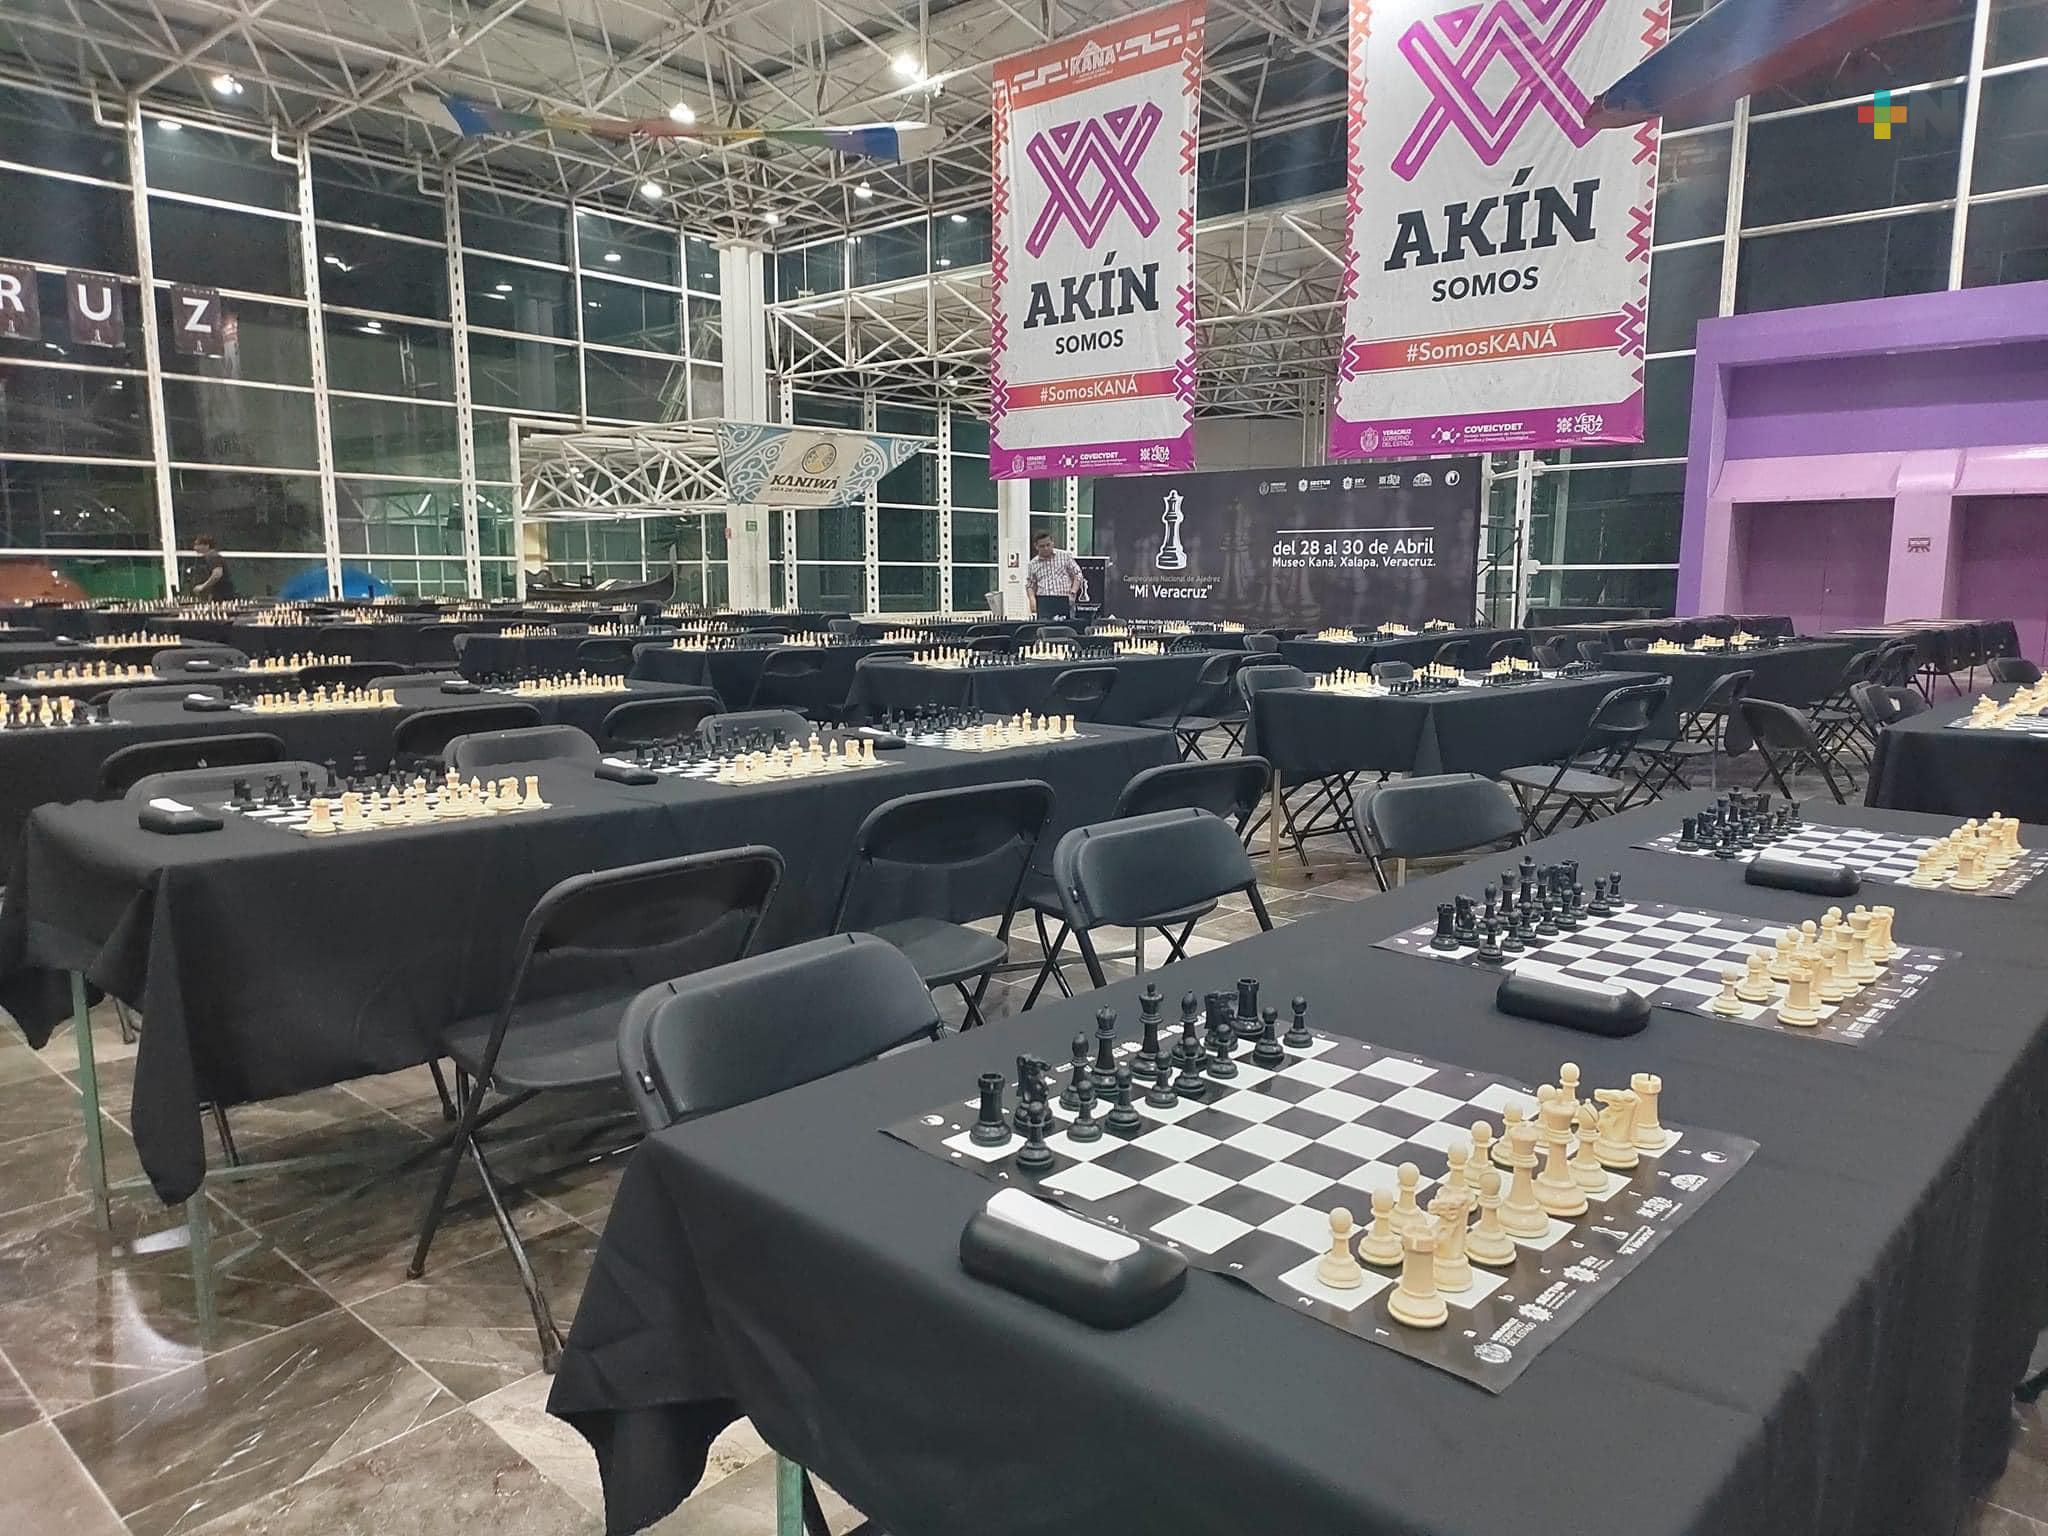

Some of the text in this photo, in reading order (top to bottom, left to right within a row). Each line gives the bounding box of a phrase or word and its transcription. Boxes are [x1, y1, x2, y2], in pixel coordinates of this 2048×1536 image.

[1383, 166, 1601, 272] AKÍN
[1023, 250, 1160, 329] AKÍN
[1431, 266, 1540, 303] SOMOS
[1055, 328, 1124, 355] SOMOS
[1406, 323, 1558, 363] #SomosKANÁ
[1040, 374, 1138, 403] #SomosKANÁ
[1464, 422, 1524, 434] COVEICYDET
[1272, 537, 1434, 556] del 28 al 30 de Abril
[1272, 555, 1436, 570] Museo Kaná, Xalapa, Veracruz.
[1129, 584, 1213, 599] "Mi Veracruz"
